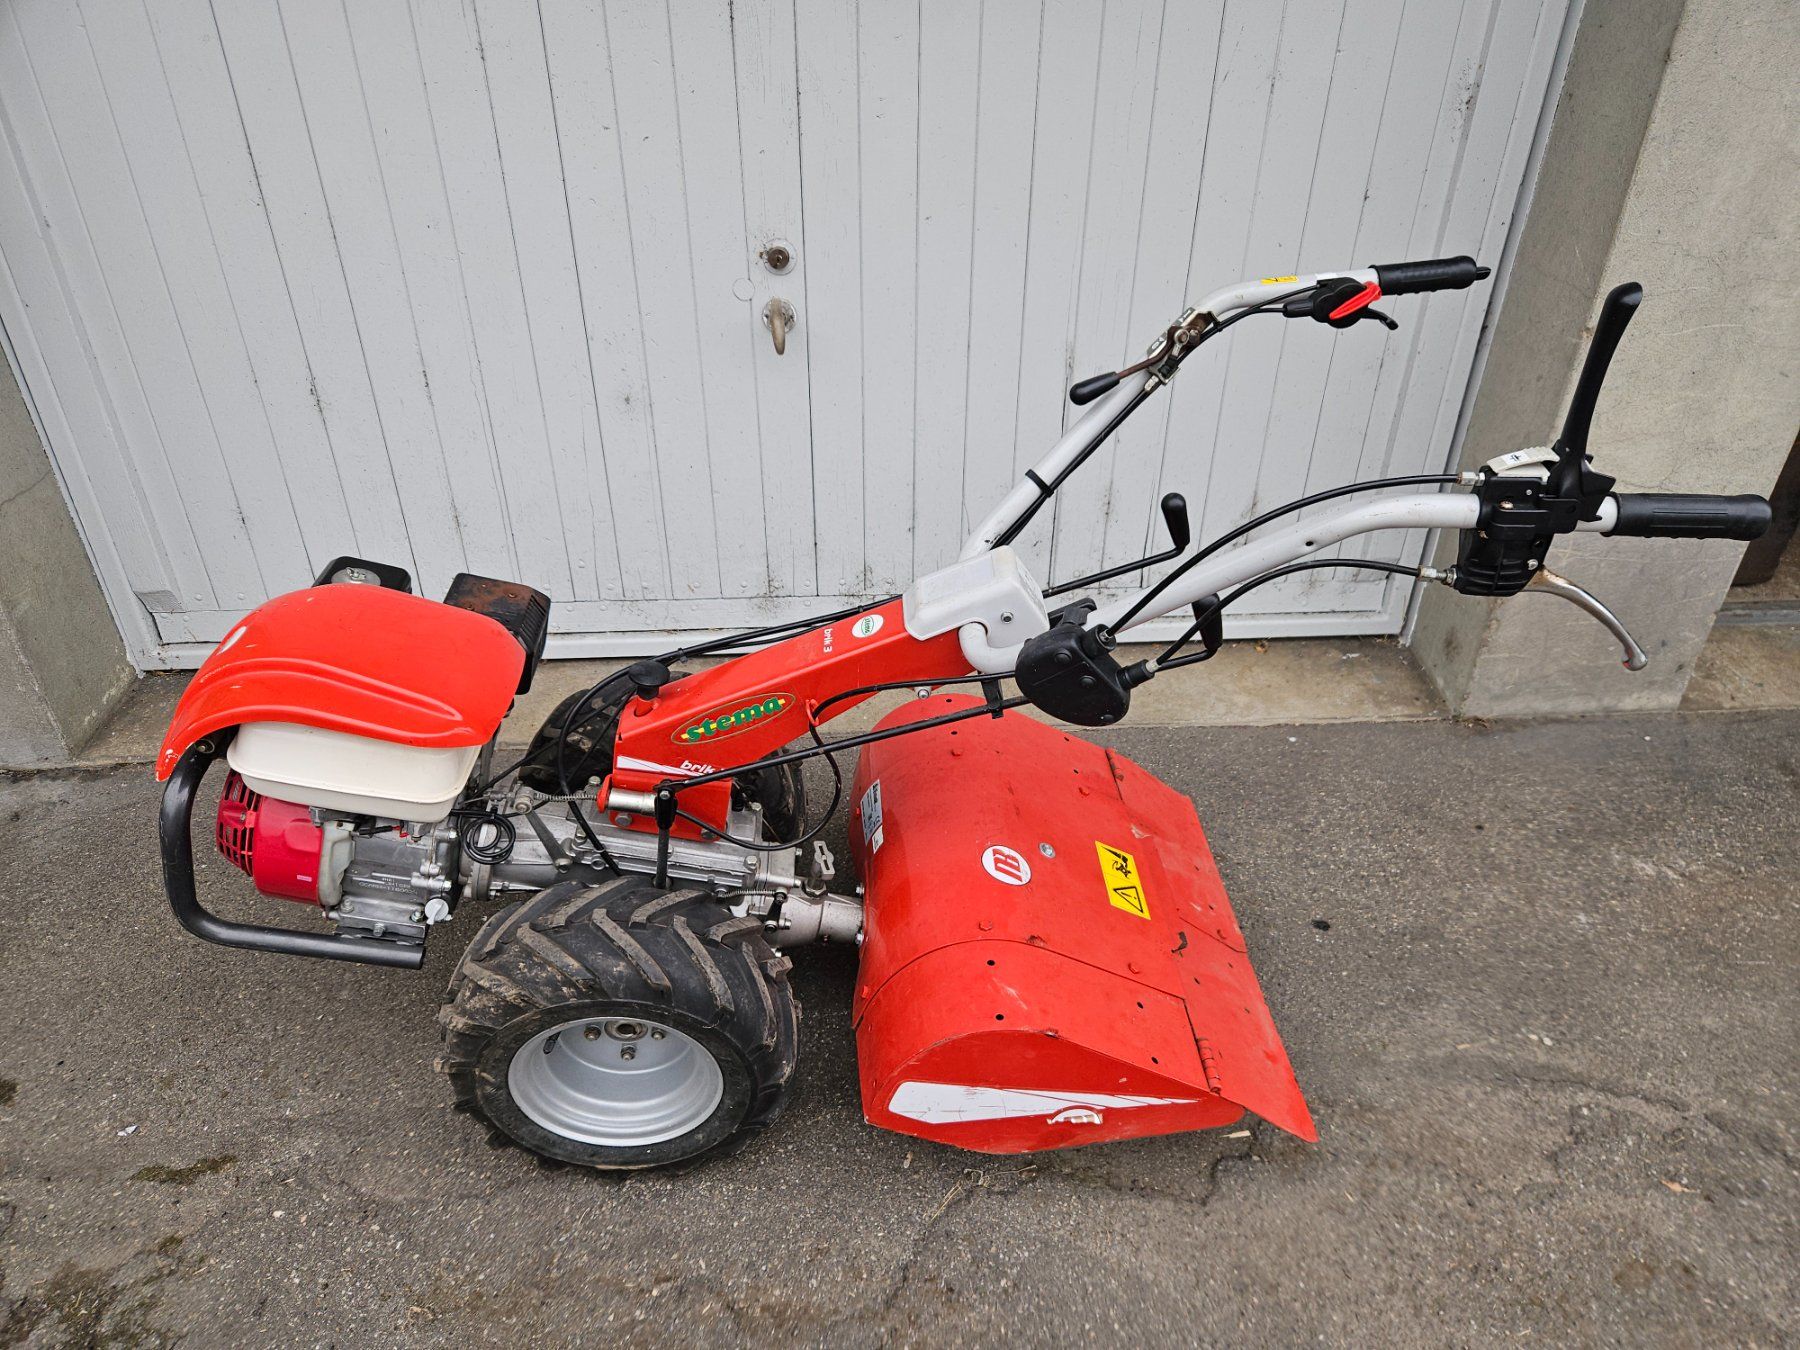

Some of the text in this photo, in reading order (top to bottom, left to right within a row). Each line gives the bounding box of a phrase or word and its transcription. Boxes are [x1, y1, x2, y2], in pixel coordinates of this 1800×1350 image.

[823, 628, 833, 646] brik
[685, 696, 782, 742] stema
[680, 760, 715, 774] brik
